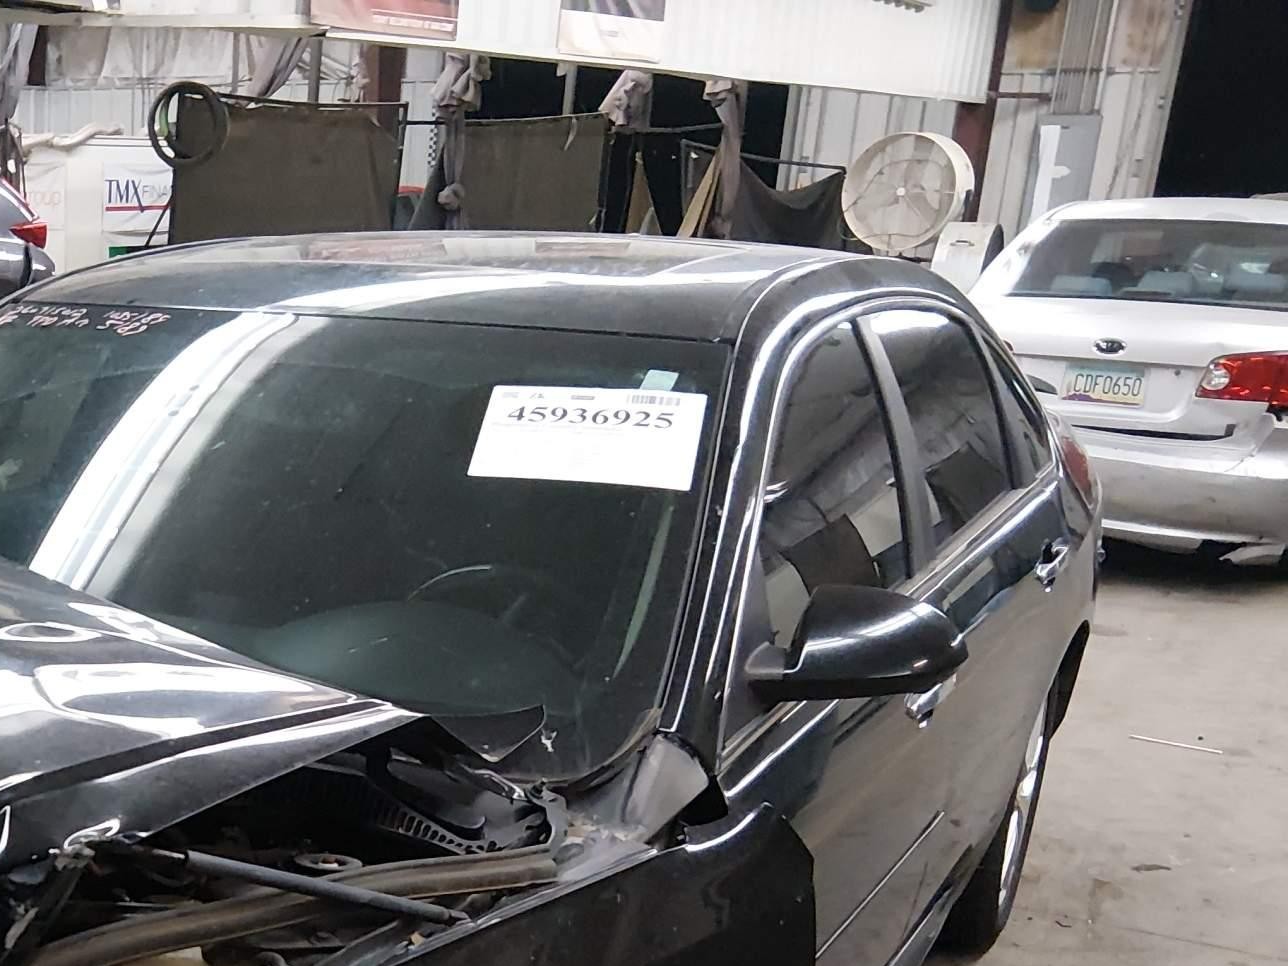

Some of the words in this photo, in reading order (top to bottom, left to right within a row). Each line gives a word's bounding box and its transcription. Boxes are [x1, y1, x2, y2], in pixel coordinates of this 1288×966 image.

[105, 178, 144, 212] TMX
[1073, 373, 1143, 397] CDF0650
[507, 405, 674, 429] 45936925
